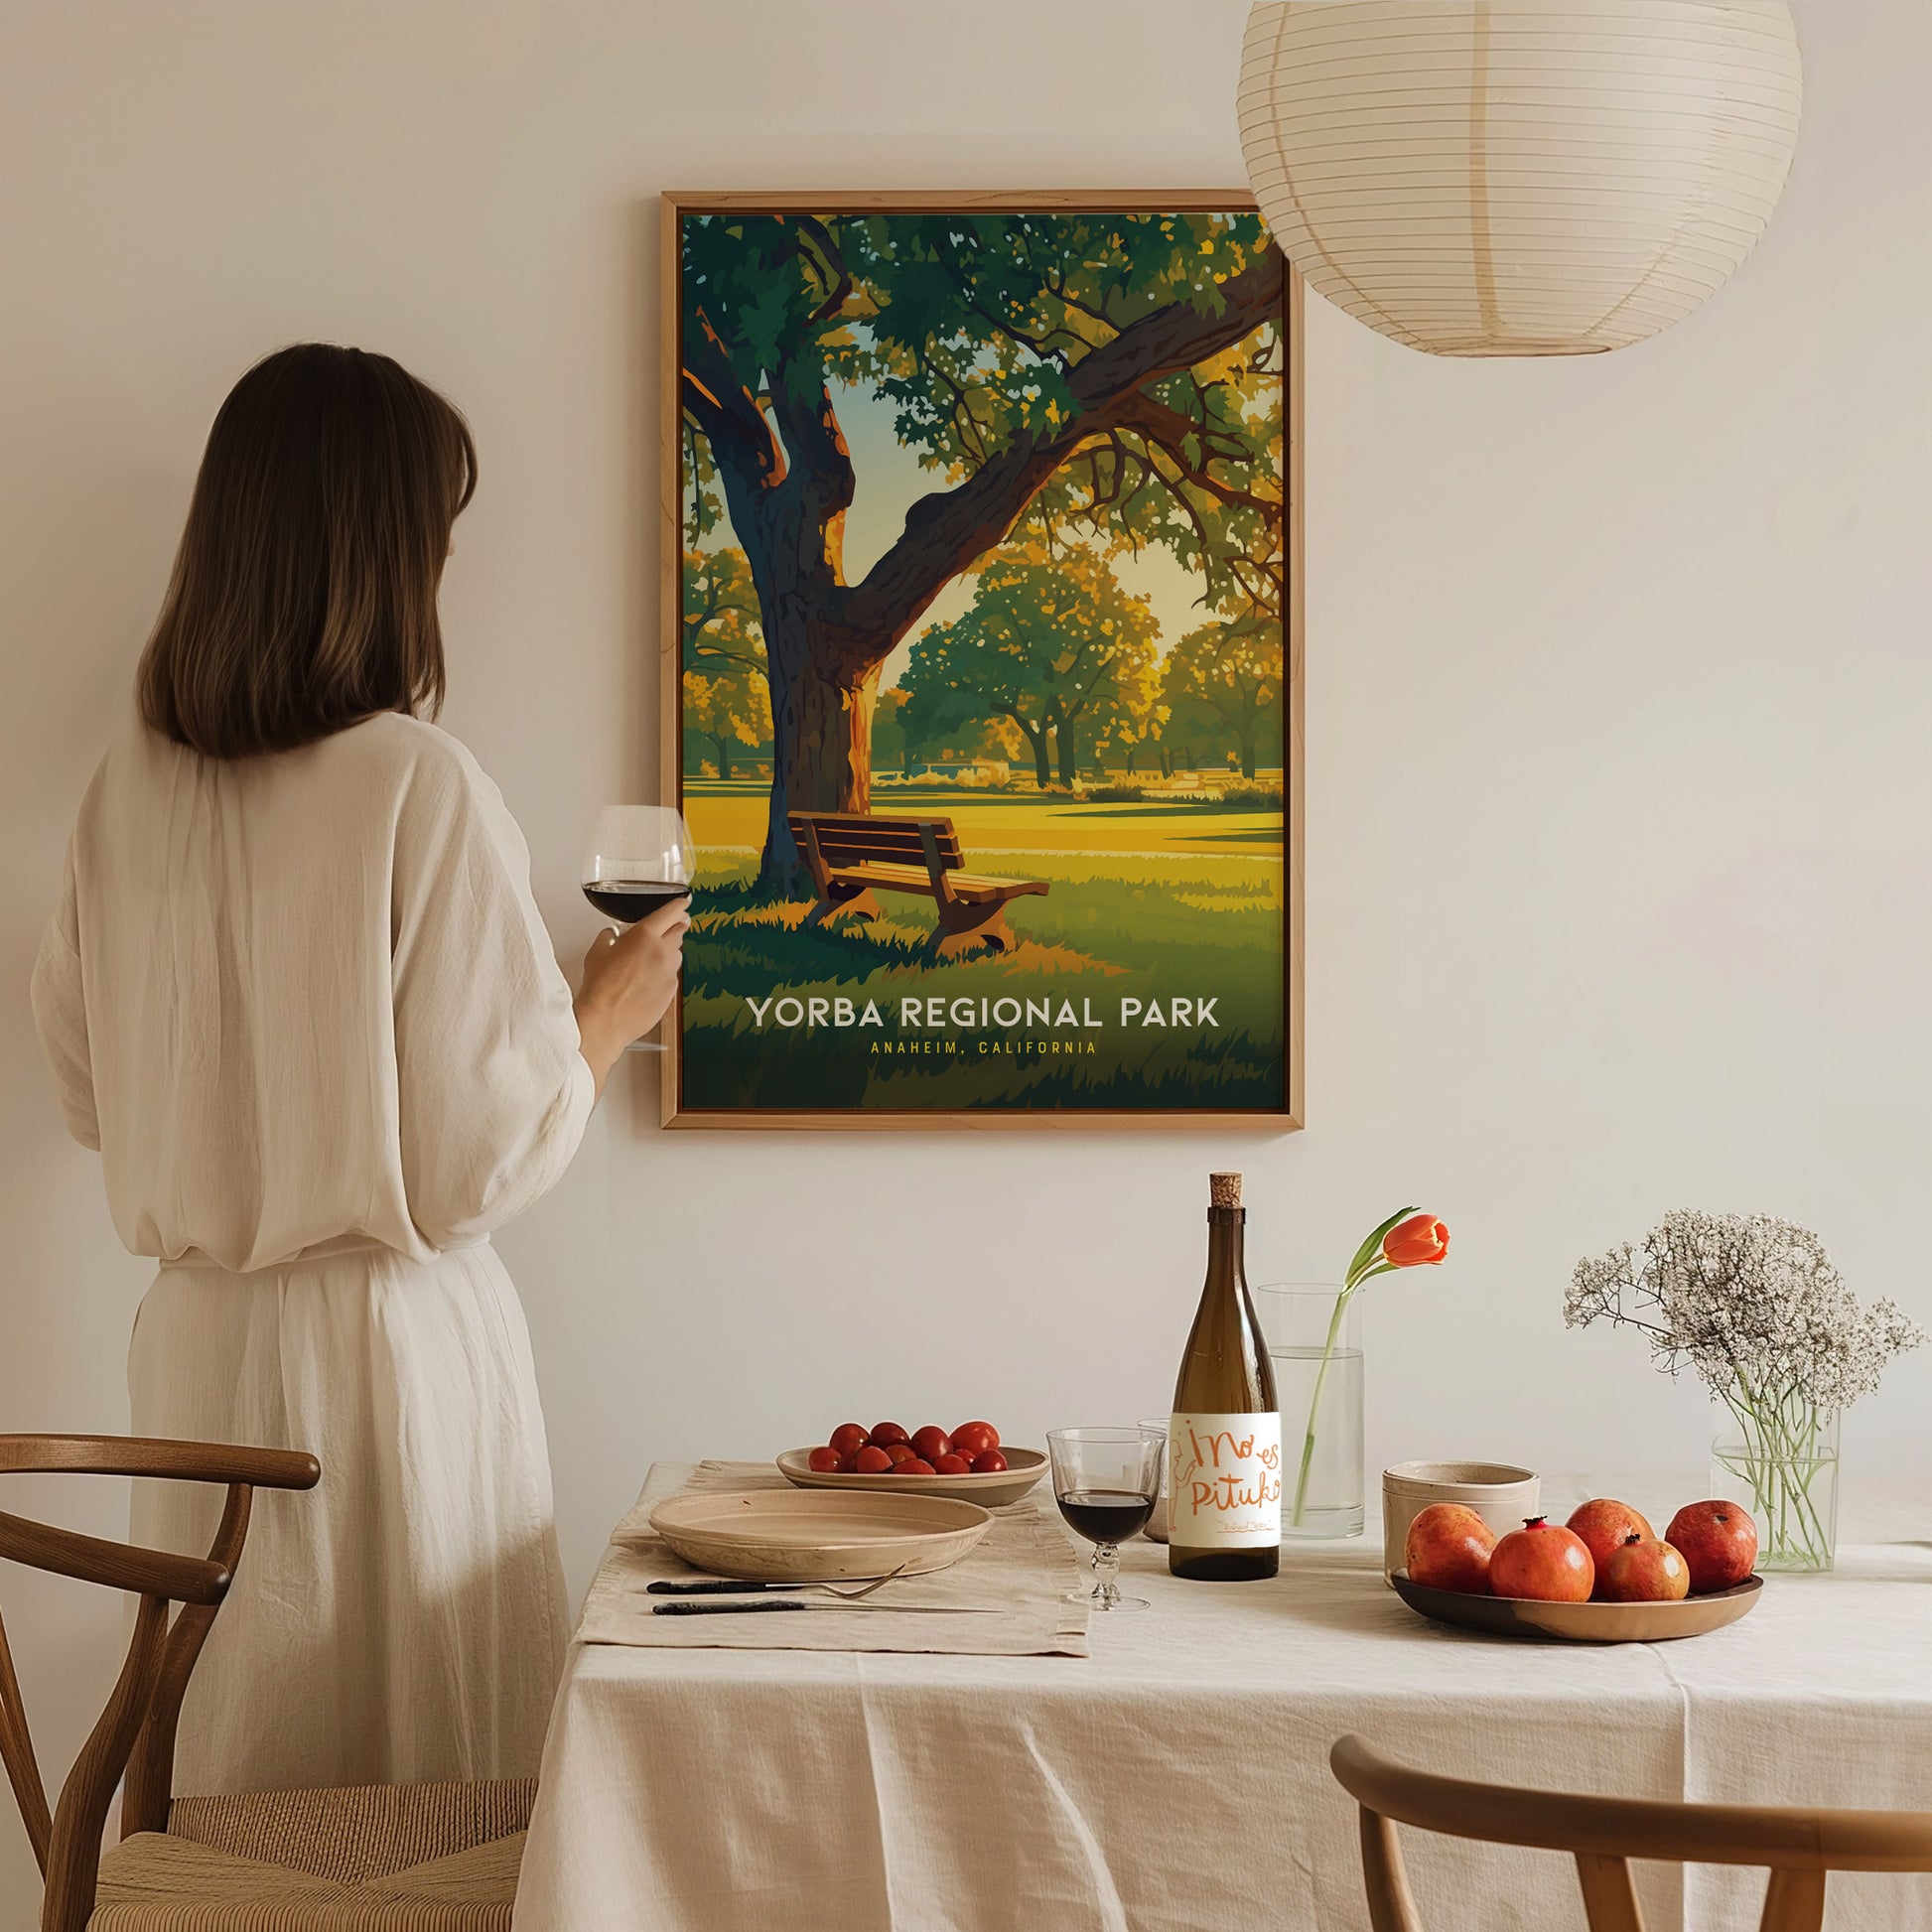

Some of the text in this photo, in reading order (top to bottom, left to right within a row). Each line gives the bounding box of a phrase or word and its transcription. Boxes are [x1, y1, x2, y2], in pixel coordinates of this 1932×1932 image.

[746, 997, 1220, 1028] YORBA REGIONAL PARK
[871, 1040, 1097, 1056] ANAHEIM, CALIFORNIA
